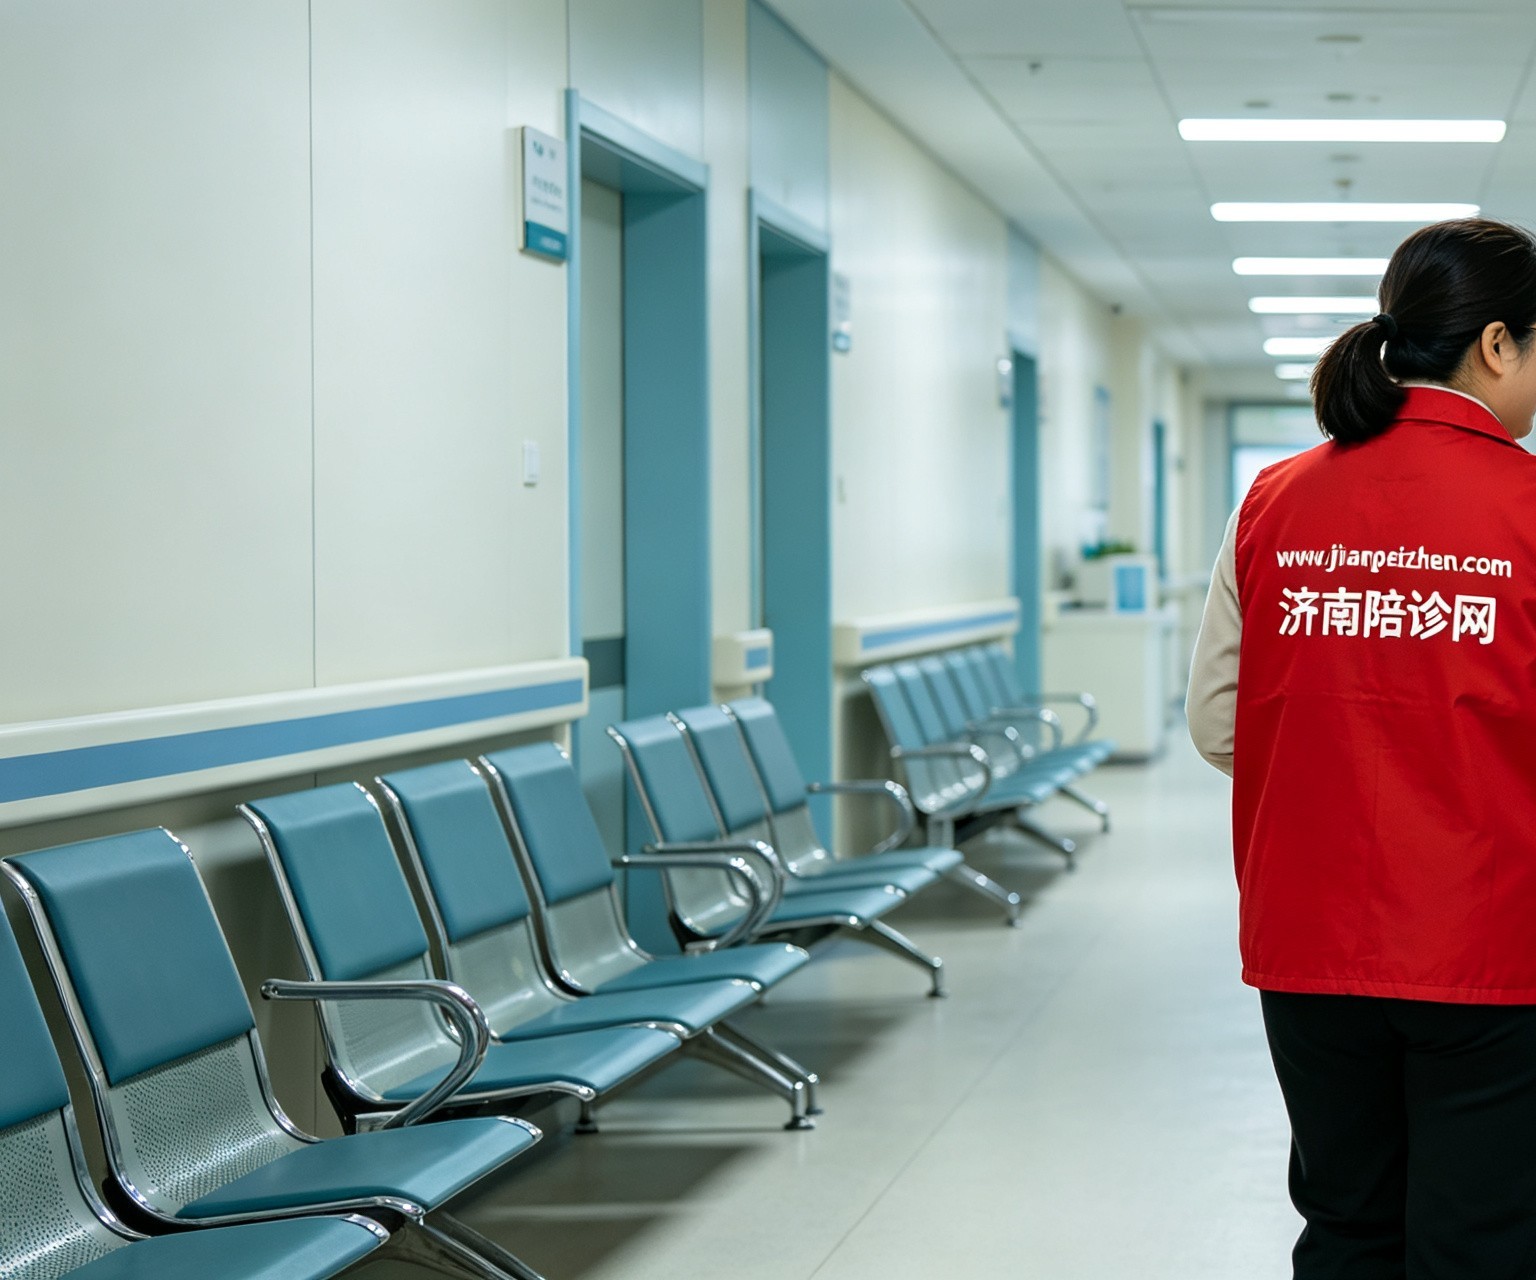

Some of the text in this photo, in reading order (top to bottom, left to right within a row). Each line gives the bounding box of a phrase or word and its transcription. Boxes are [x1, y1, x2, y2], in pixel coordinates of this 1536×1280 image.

[1278, 586, 1497, 645] 济南陪诊网
